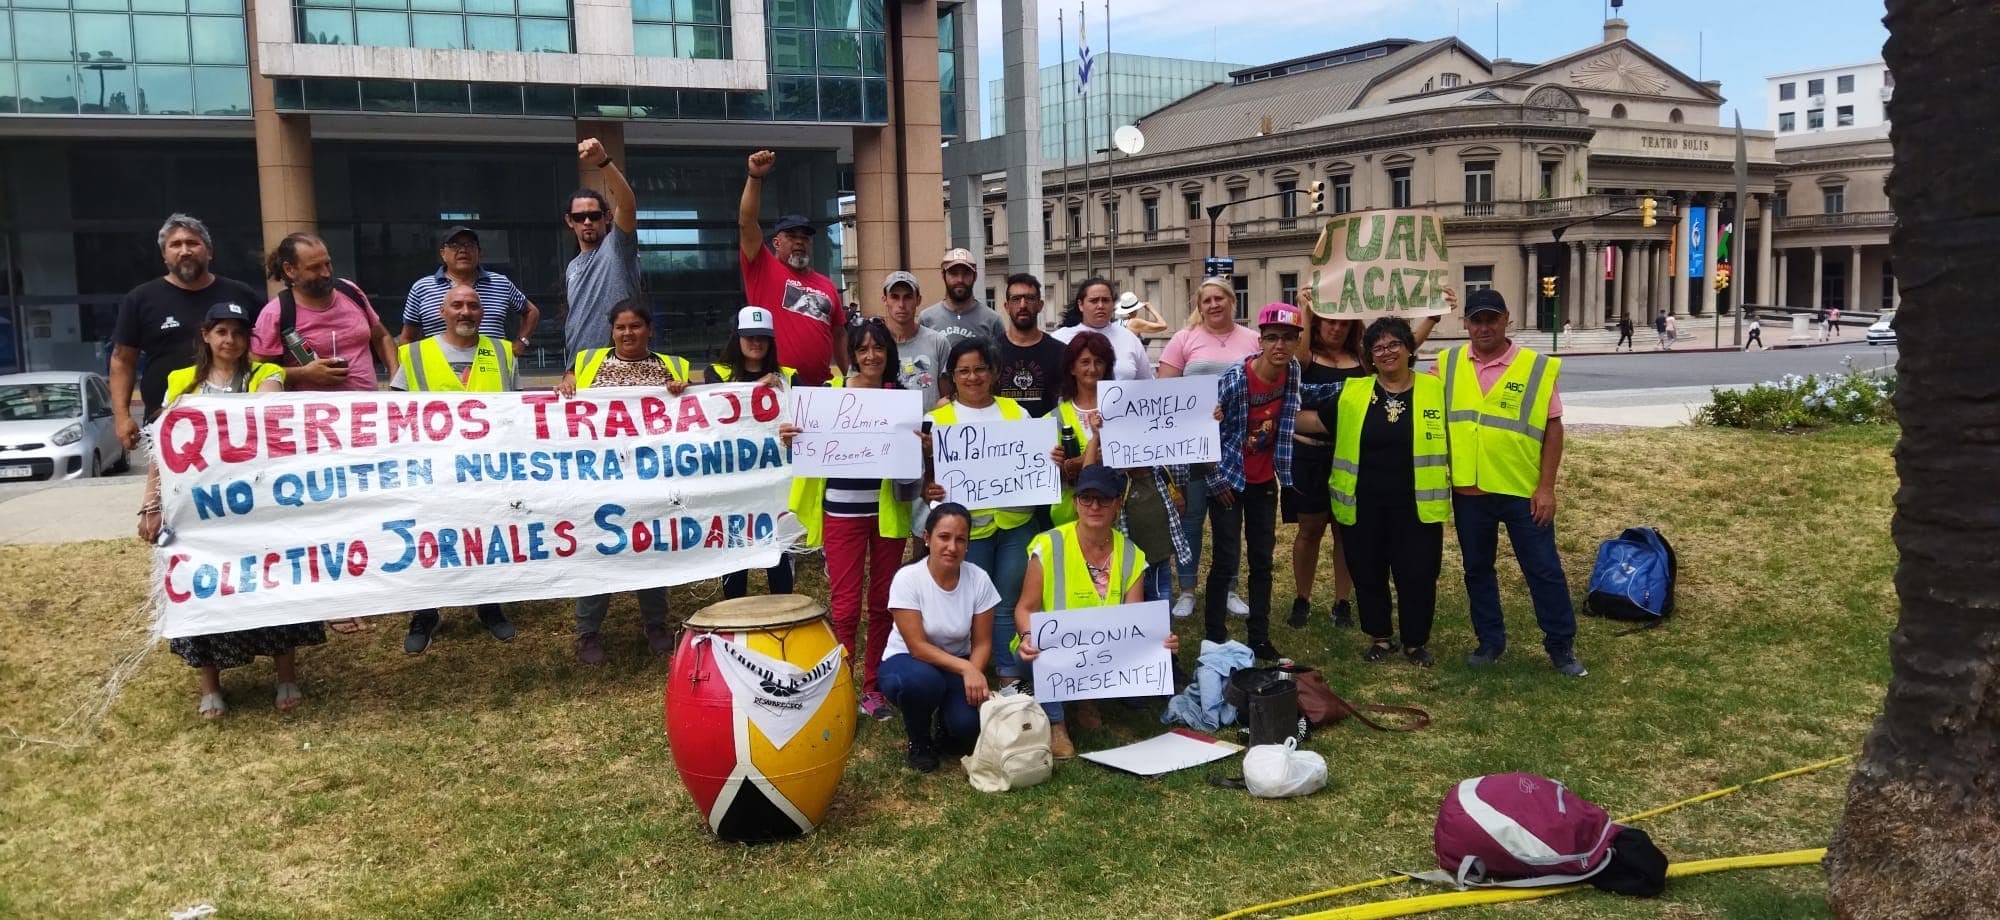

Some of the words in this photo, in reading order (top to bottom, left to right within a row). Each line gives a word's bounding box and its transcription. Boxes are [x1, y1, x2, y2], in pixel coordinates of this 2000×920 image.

[1641, 136, 1678, 150] TEATRO
[1311, 215, 1449, 266] JUAN
[1312, 266, 1449, 314] LACAZE
[1101, 386, 1197, 421] CARMELO
[1504, 382, 1525, 393] ABC
[159, 399, 491, 474] QUEREMOS
[521, 385, 780, 440] TRABAJO
[1423, 409, 1441, 420] ABC
[191, 480, 254, 520] NO
[272, 458, 434, 508] QUITEN
[455, 449, 624, 482] NUESTRA
[635, 437, 792, 481] DIGNIDA
[164, 540, 369, 603] COLECTIVO
[380, 519, 578, 573] JORNALES
[594, 503, 789, 556] SOLIDARIO
[1037, 619, 1146, 651] COLONIA
